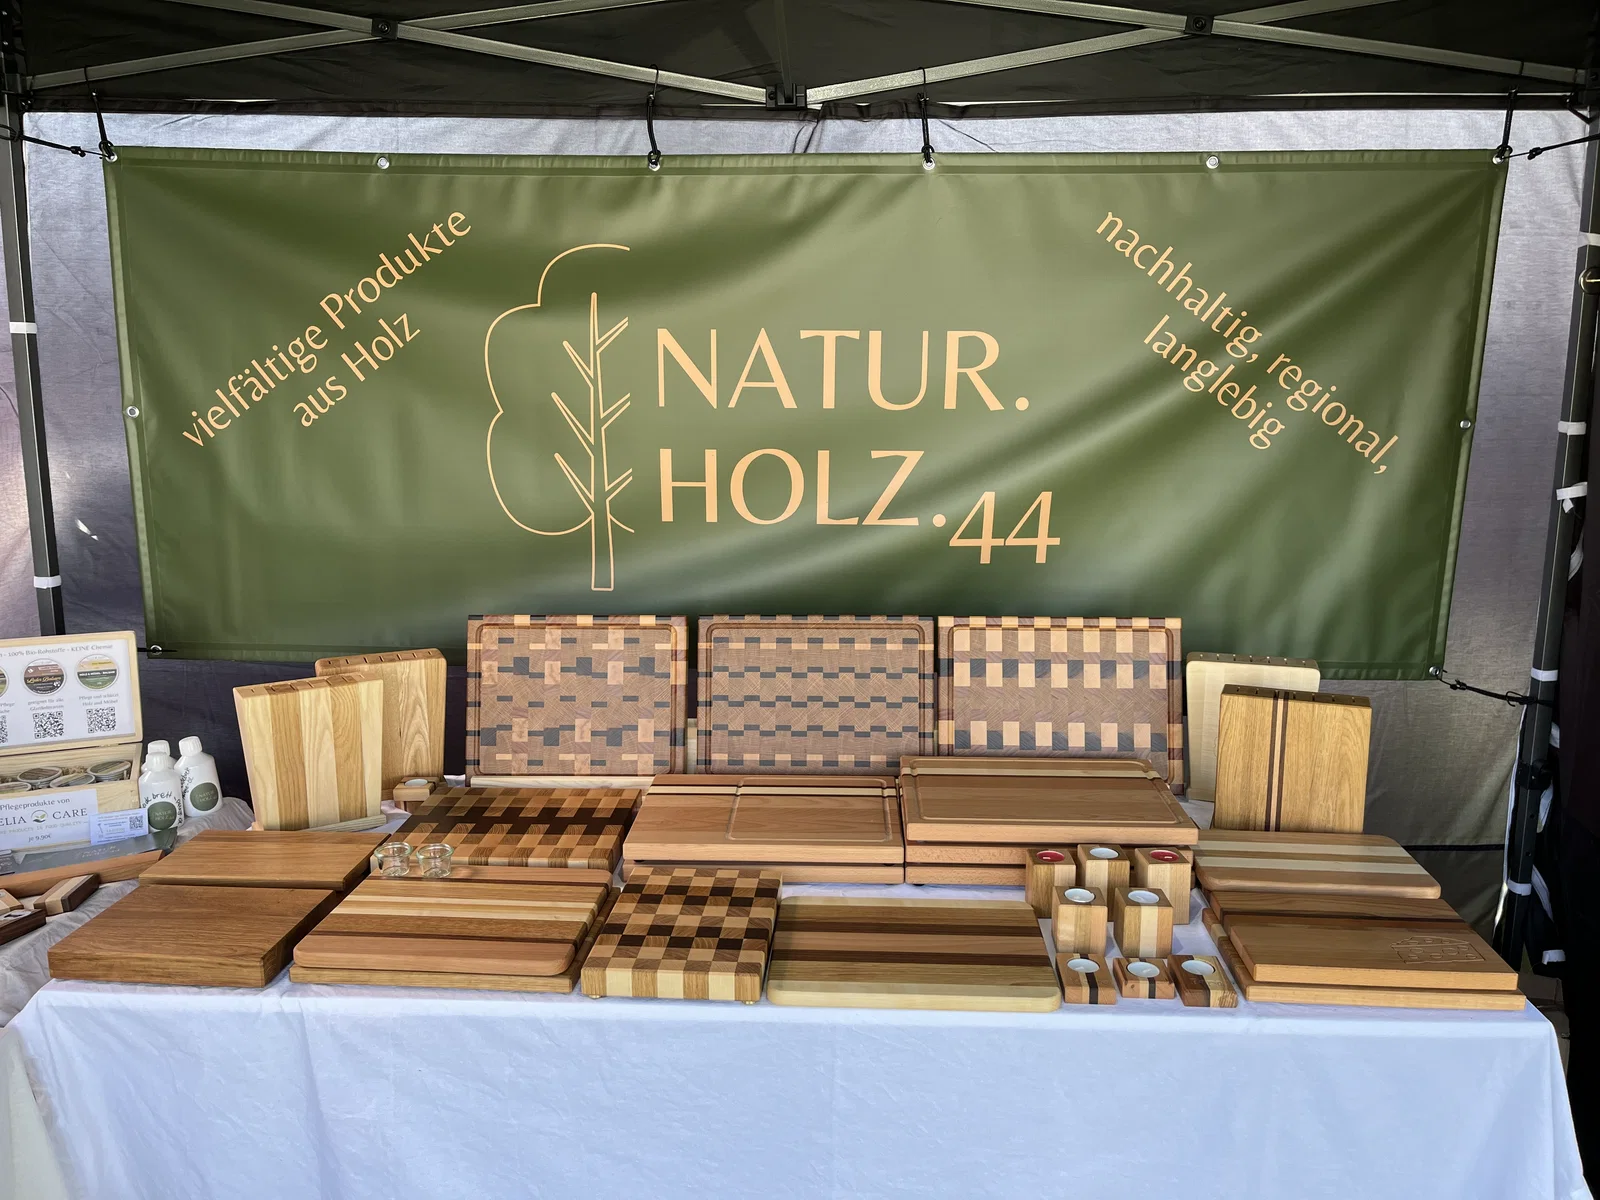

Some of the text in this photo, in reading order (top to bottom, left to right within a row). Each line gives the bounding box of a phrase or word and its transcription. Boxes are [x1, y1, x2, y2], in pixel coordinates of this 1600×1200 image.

[183, 211, 472, 448] vielfältige Produkte
[293, 312, 421, 428] aus Holz
[656, 327, 1031, 412] NATUR.
[1096, 211, 1399, 475] nachhaltig, regional,
[1144, 313, 1285, 450] langlebig
[0, 800, 56, 811] Pflegeprodukte
[52, 808, 88, 820] CARE
